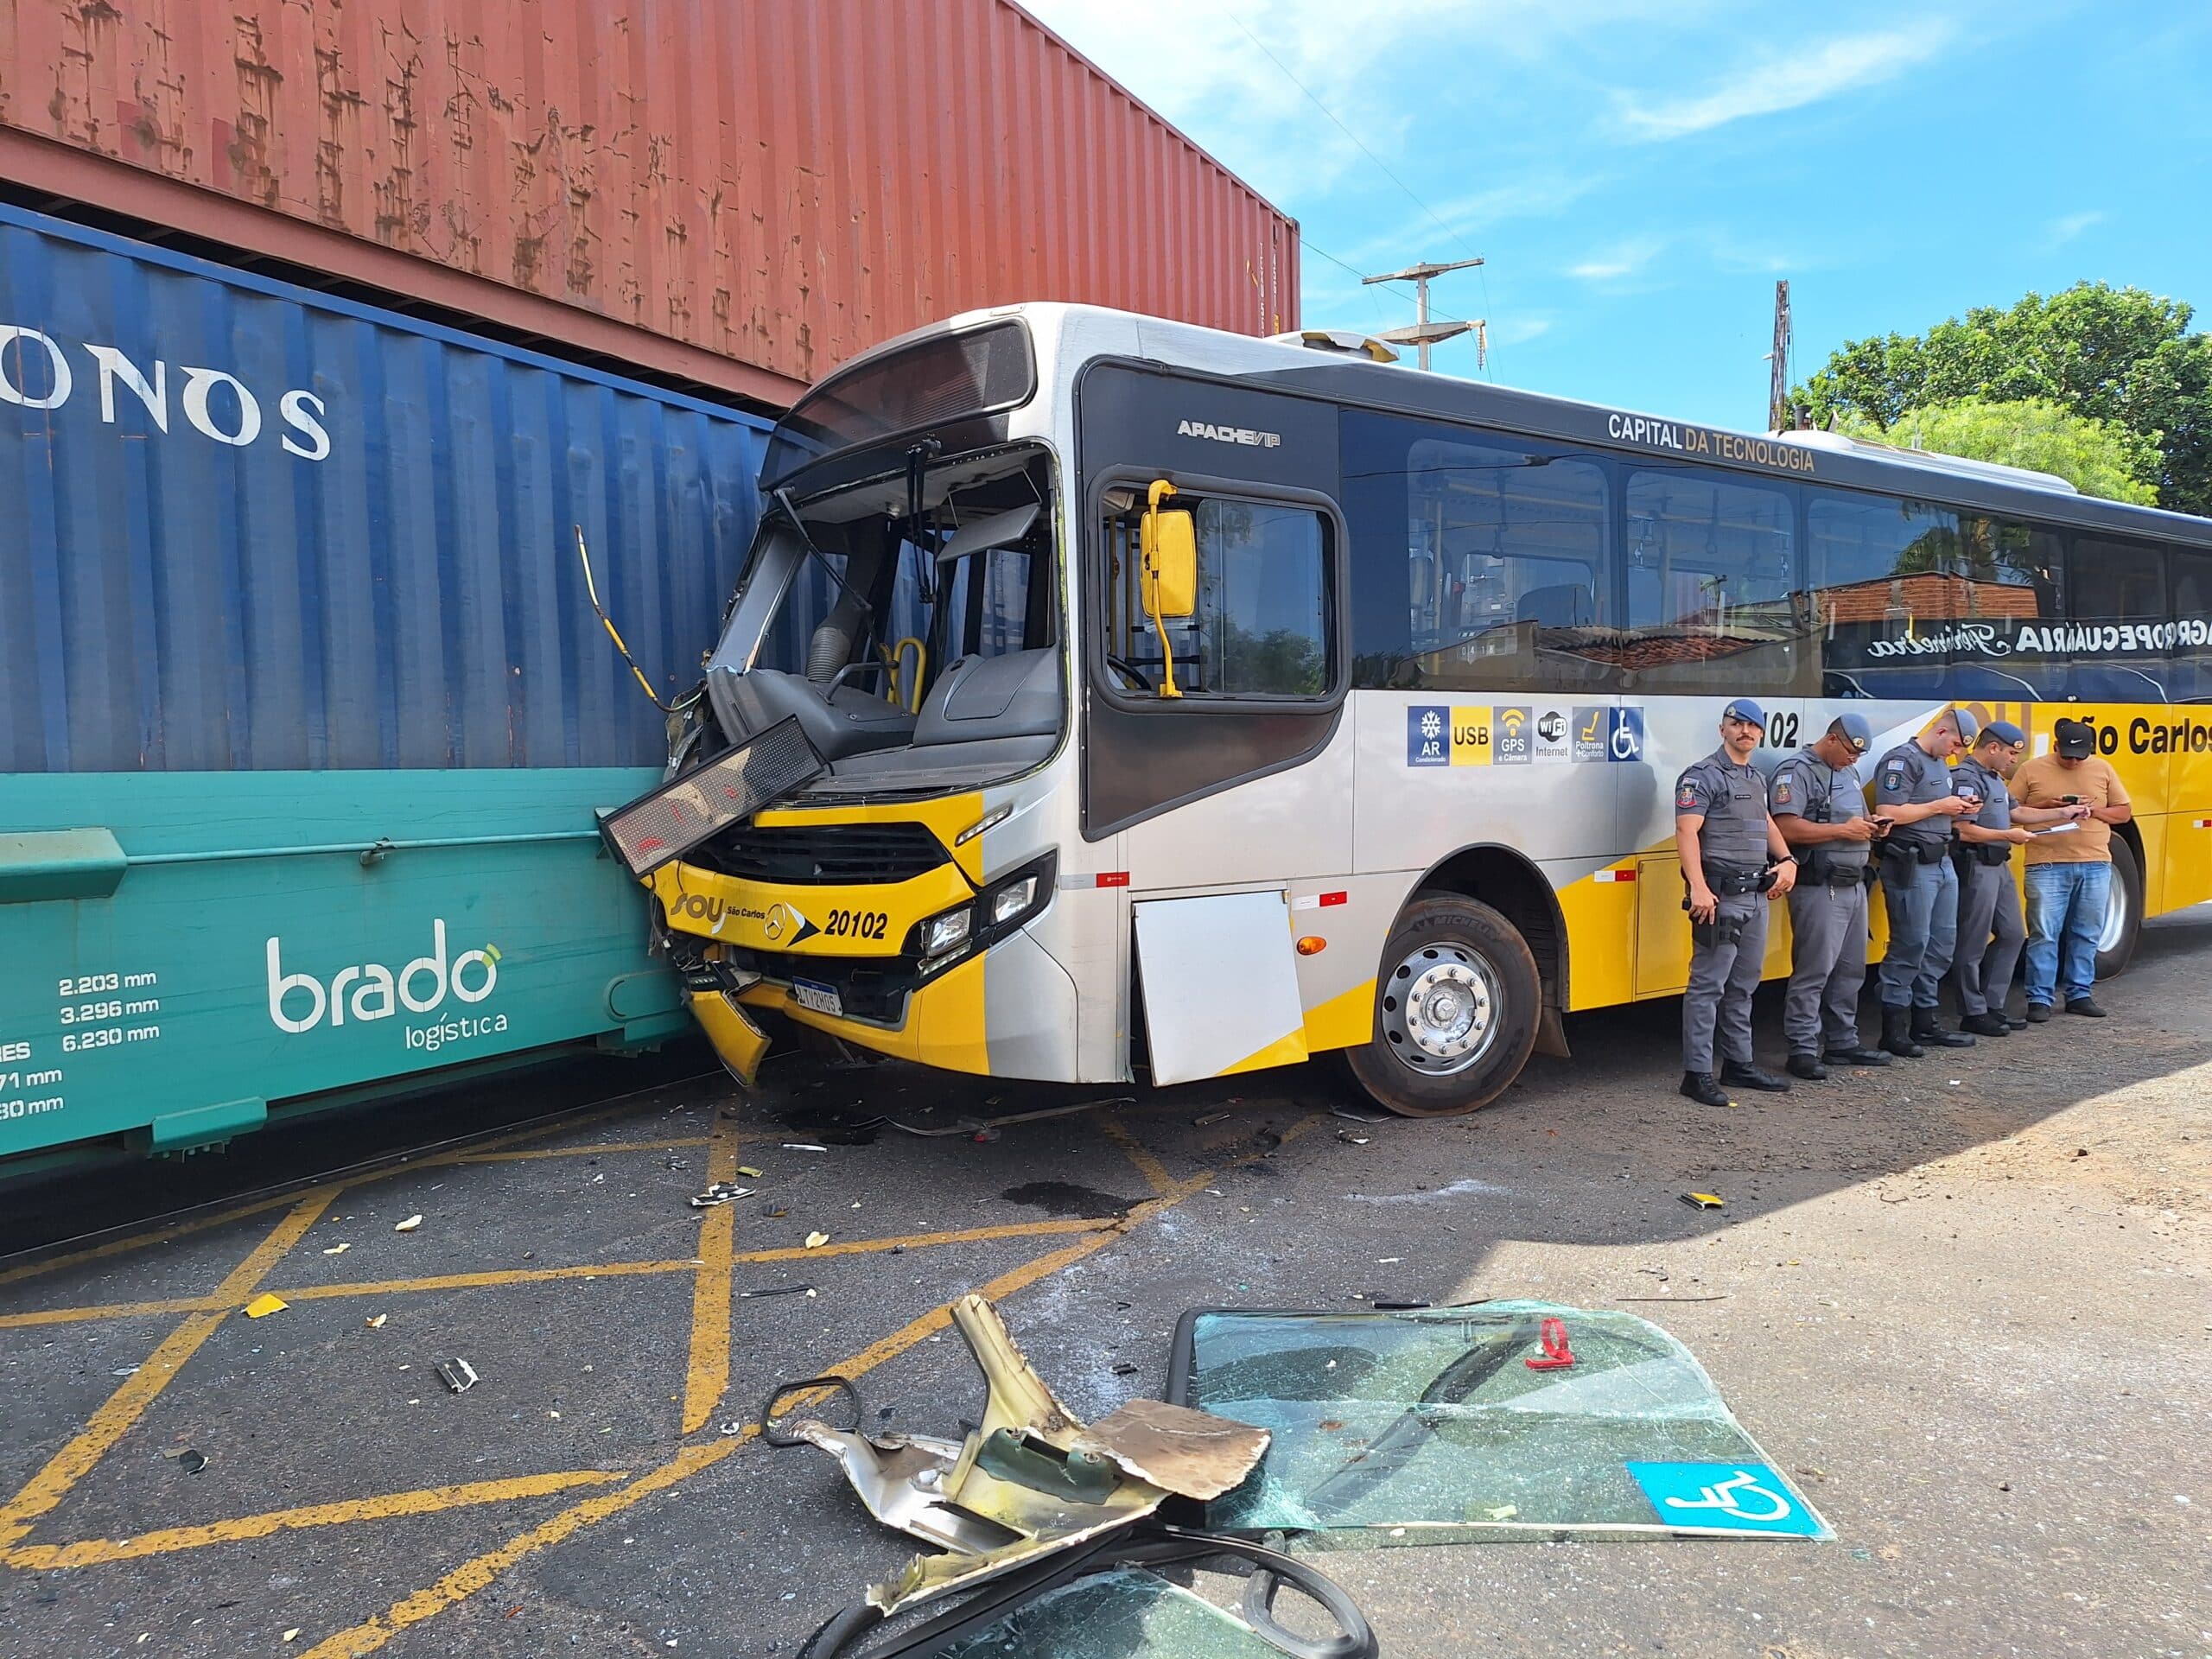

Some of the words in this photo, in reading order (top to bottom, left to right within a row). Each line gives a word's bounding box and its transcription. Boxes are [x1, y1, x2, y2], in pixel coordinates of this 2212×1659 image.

[0, 324, 331, 461] ONOS
[1608, 414, 1683, 449] CAPITAL
[1685, 428, 1709, 454] DA
[1713, 433, 1815, 472] TECNOLOGIA
[1454, 727, 1489, 745] USB
[1759, 711, 1799, 748] 102
[1421, 741, 1440, 756] AR
[1502, 739, 1525, 752] GPS
[1536, 746, 1568, 757] Internet
[727, 906, 741, 916] São
[741, 908, 766, 919] Carlos
[824, 910, 888, 940] 20102
[59, 973, 119, 996] 2.203
[124, 972, 157, 988] mm
[266, 918, 499, 1033] brado
[60, 1001, 123, 1024] 3.296
[126, 999, 159, 1015] mm
[62, 1027, 123, 1052] 6.230
[127, 1026, 160, 1042] mm
[405, 1012, 508, 1052] logística
[0, 1041, 31, 1062] ES
[27, 1069, 63, 1086] mm
[28, 1096, 64, 1115] mm
